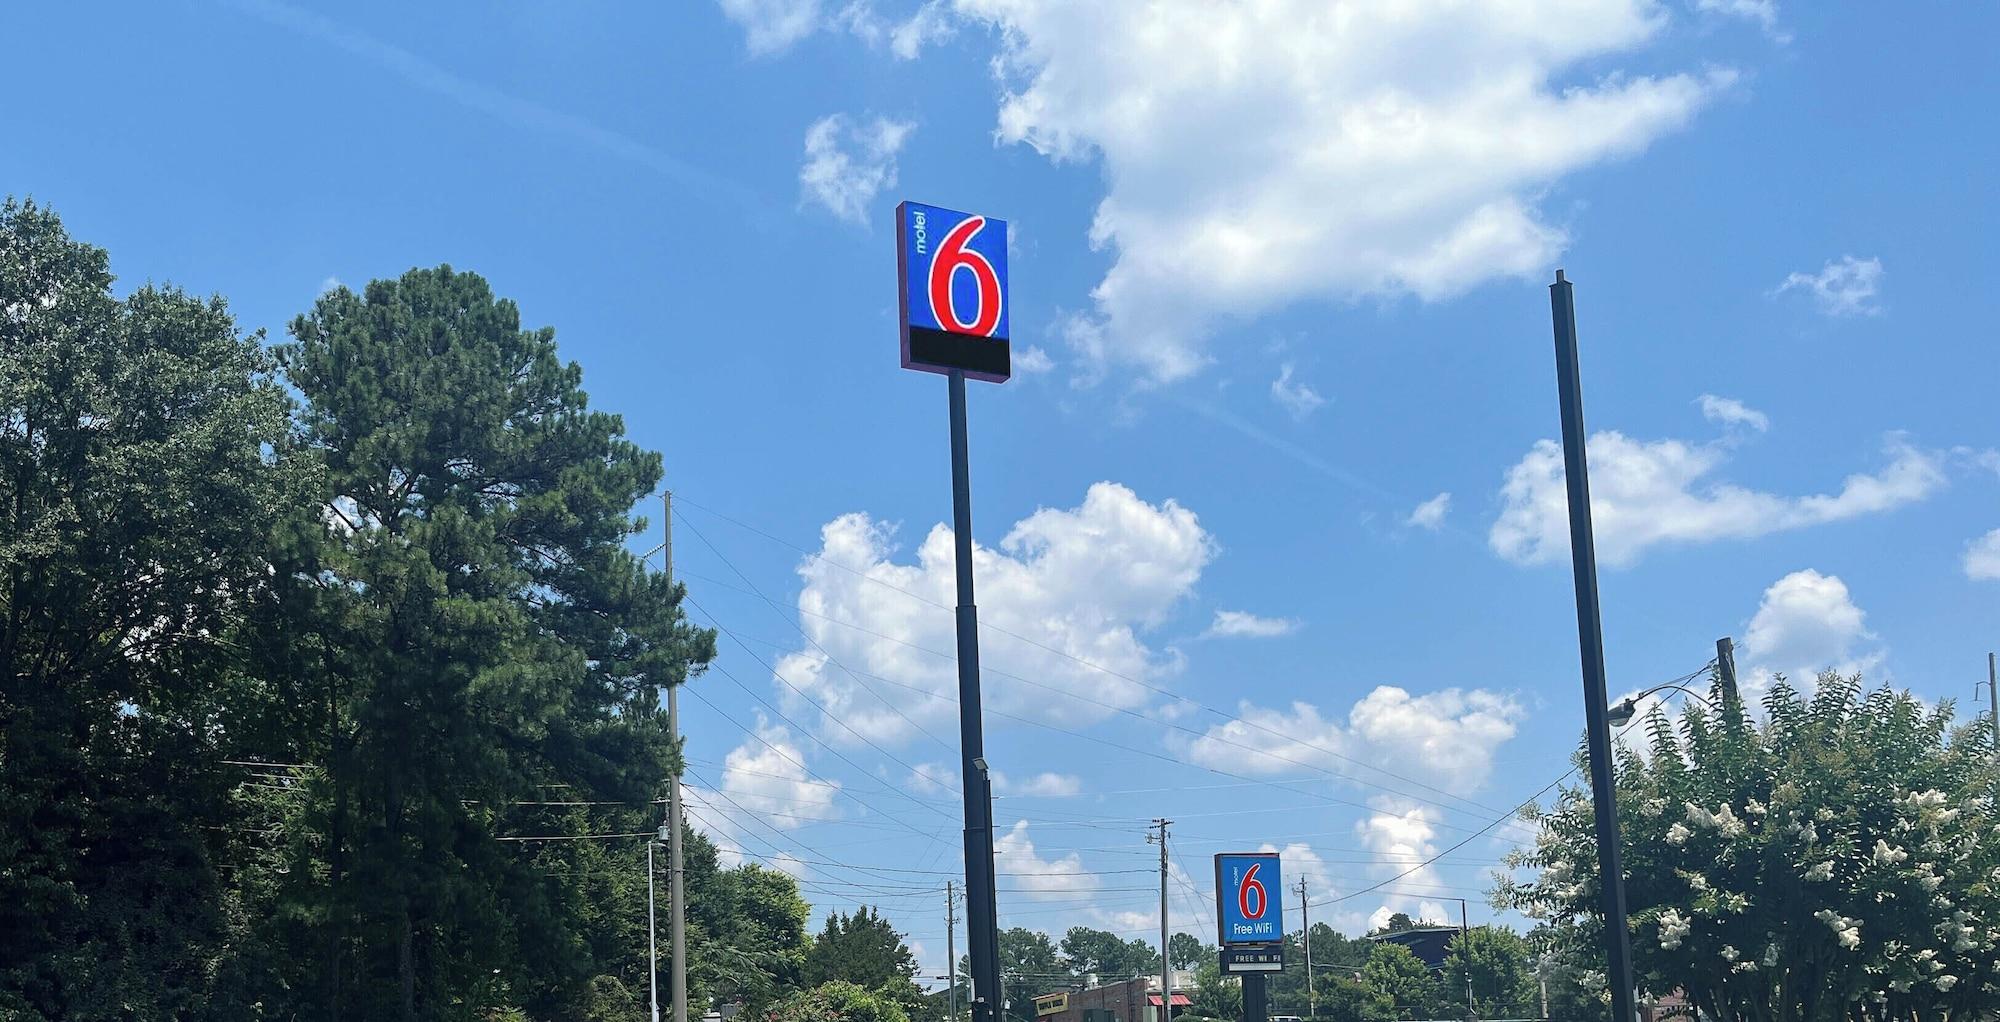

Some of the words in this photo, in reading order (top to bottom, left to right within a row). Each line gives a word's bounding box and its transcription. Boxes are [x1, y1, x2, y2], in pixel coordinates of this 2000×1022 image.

[913, 211, 926, 254] motel
[928, 215, 1002, 337] 6
[1238, 863, 1267, 919] 6
[1233, 923, 1253, 934] Free
[1254, 922, 1273, 933] WiFi
[1235, 954, 1254, 962] FREE
